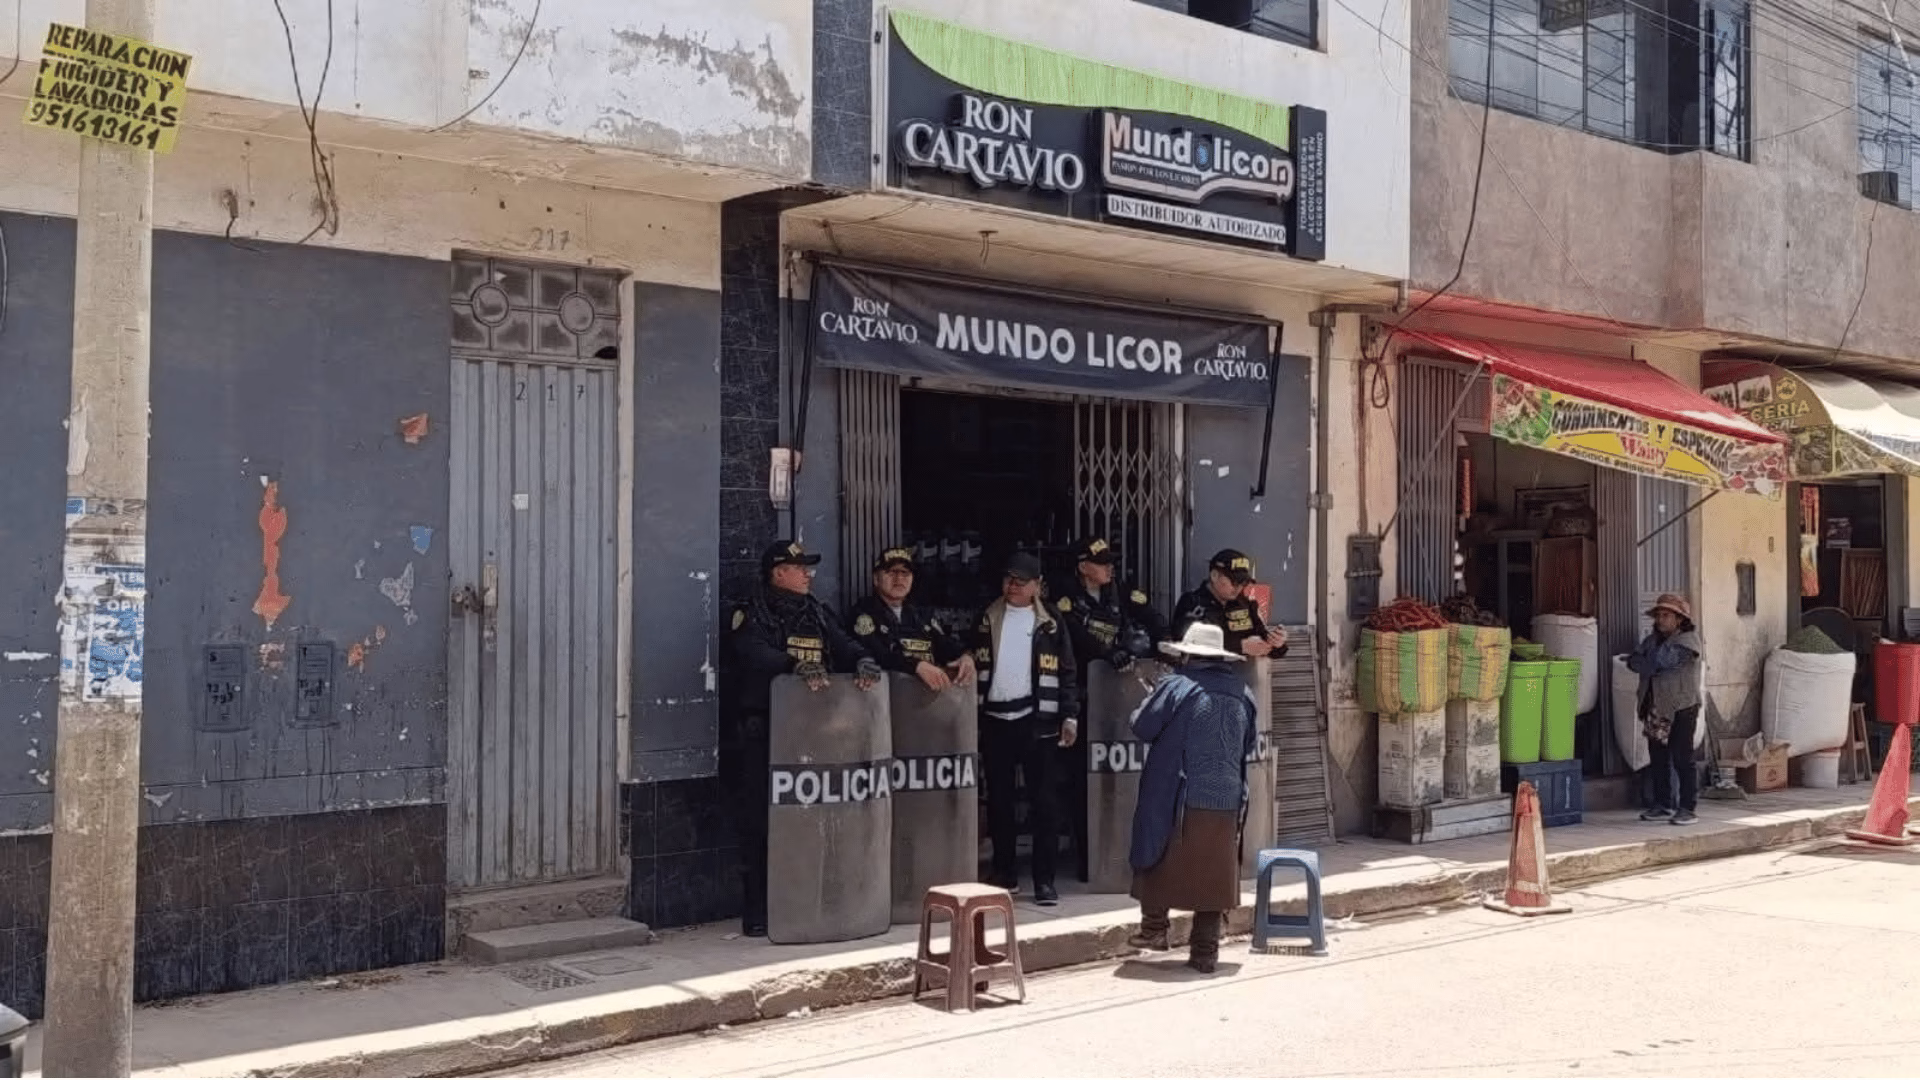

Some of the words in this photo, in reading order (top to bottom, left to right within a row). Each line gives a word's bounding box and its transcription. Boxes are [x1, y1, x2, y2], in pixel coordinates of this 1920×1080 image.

[46, 22, 188, 79] REPARACION
[34, 77, 178, 127] LAVADORAS
[156, 79, 174, 102] Y
[963, 94, 1034, 140] RON
[905, 122, 1084, 190] CARTAVIO
[530, 227, 570, 250] 217
[1110, 197, 1202, 226] DISTRIBUIDOR
[1208, 218, 1286, 242] AUTORIZADO
[852, 296, 890, 318] RON
[936, 312, 1075, 364] MUNDO
[1087, 331, 1183, 375] LICOR
[1217, 343, 1246, 358] RON
[1656, 424, 1666, 440] Y
[772, 765, 891, 804] POLICIA
